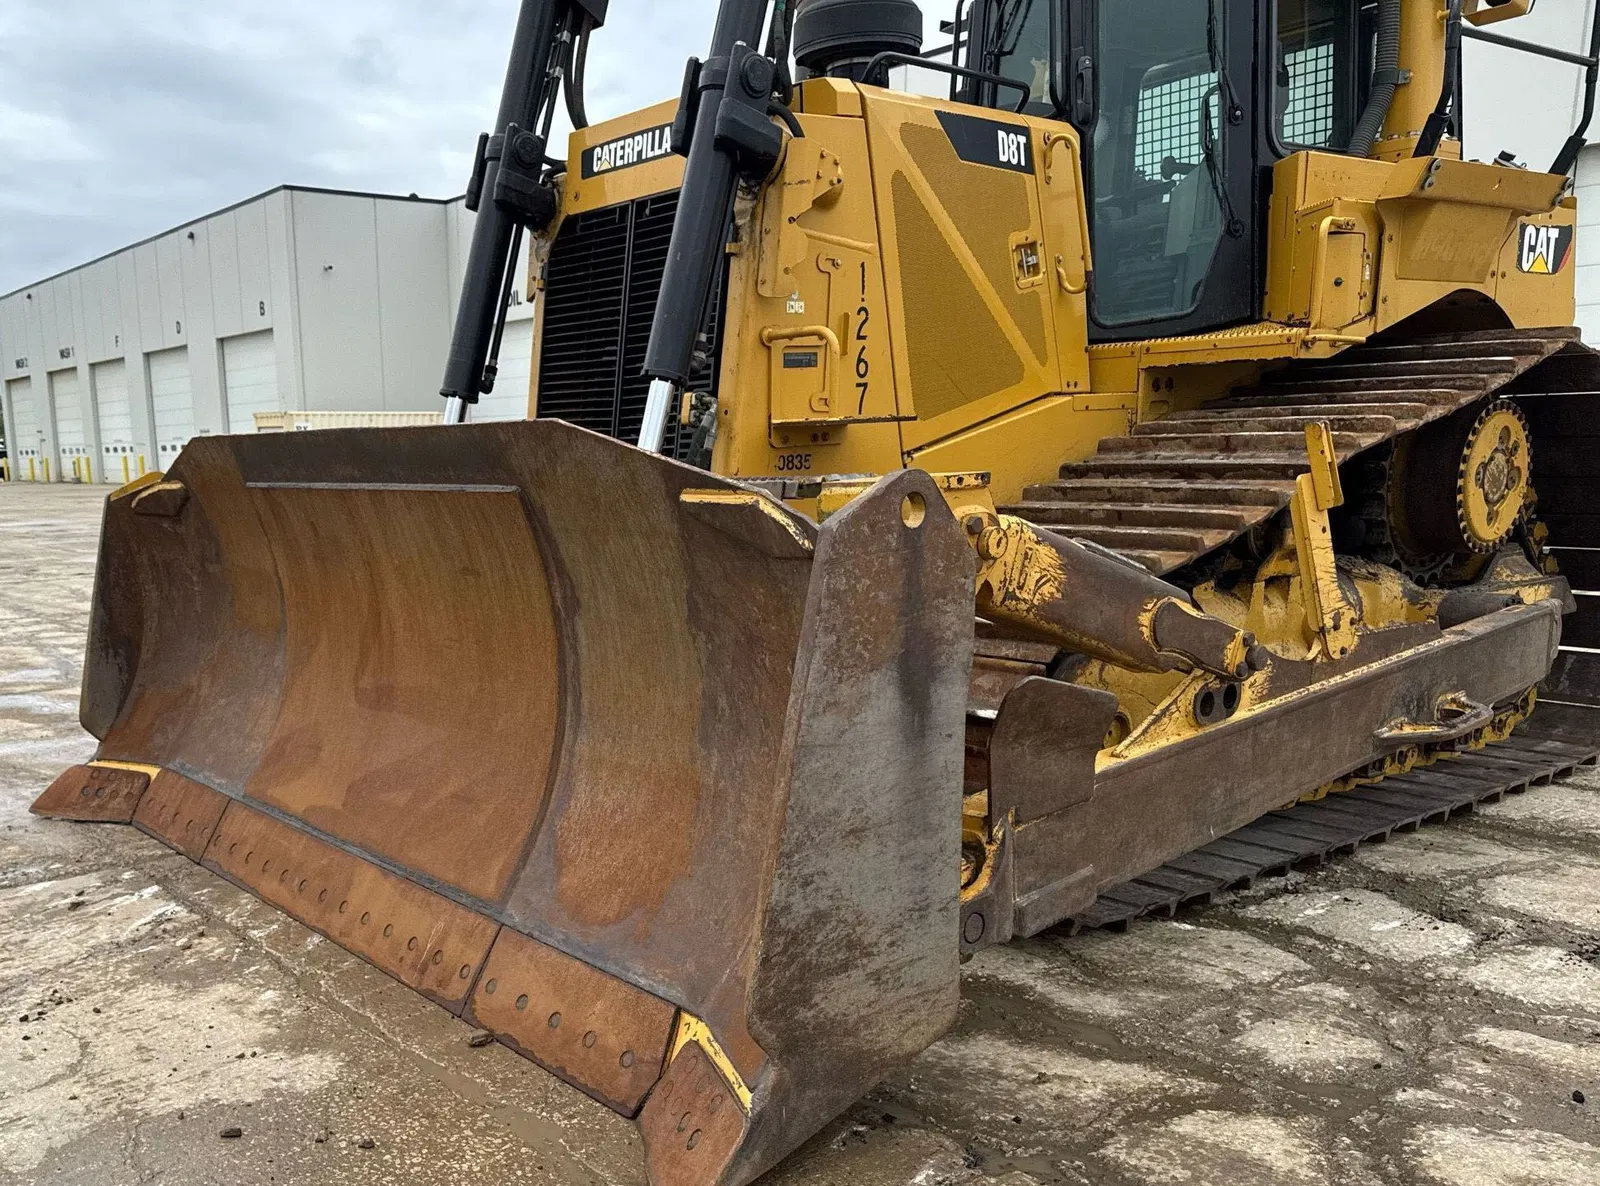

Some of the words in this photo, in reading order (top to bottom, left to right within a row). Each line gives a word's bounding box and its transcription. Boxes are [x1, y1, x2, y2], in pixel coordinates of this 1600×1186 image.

[593, 126, 672, 173] CATERPILLA
[997, 129, 1027, 167] D8T
[1521, 224, 1559, 274] CAT
[259, 300, 266, 316] B
